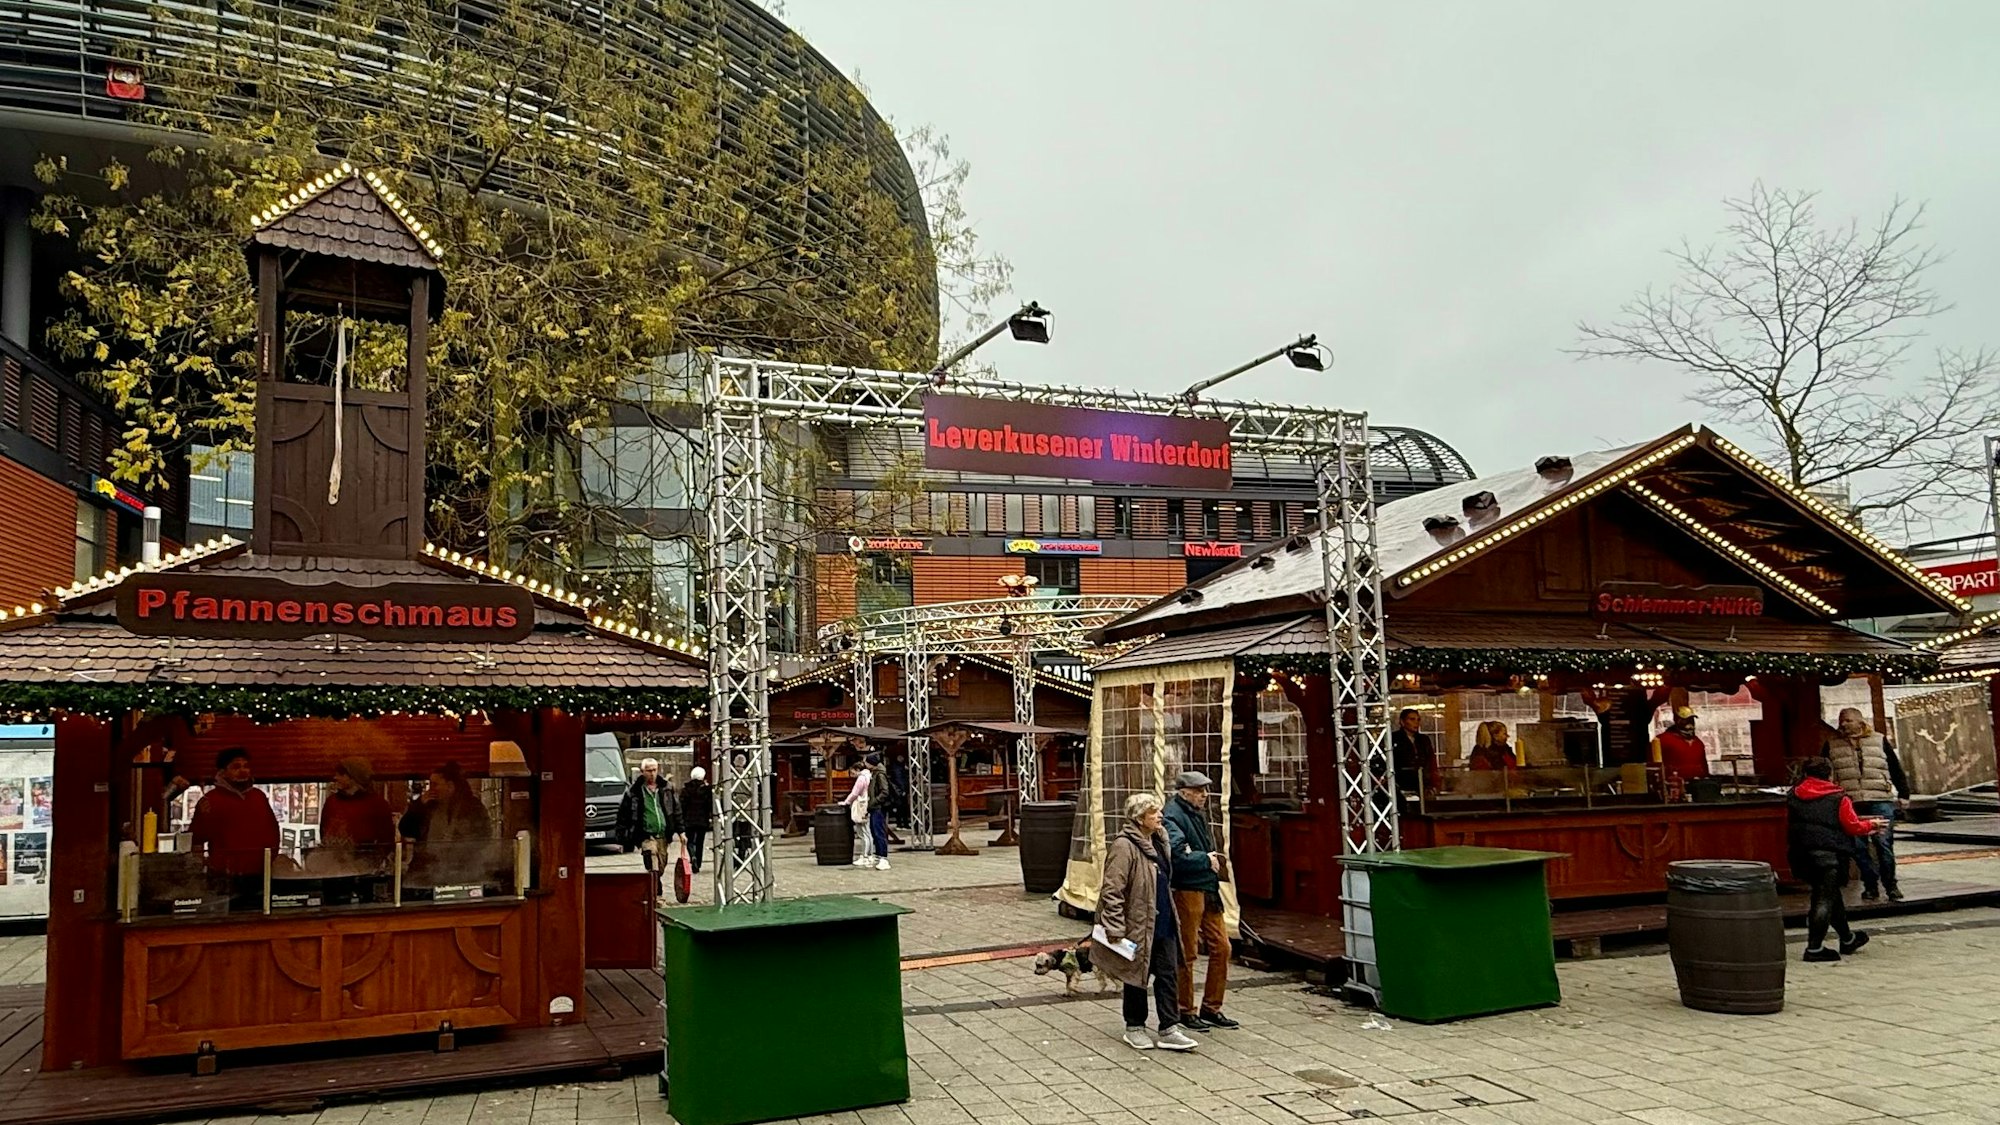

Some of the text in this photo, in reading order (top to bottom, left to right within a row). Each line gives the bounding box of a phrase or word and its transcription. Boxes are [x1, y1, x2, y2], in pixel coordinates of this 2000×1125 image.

[928, 417, 1230, 470] Leverkusener Winterdorf
[138, 589, 518, 628] Pfannenschmaus
[1598, 593, 1763, 615] Schlemmer-Hütte
